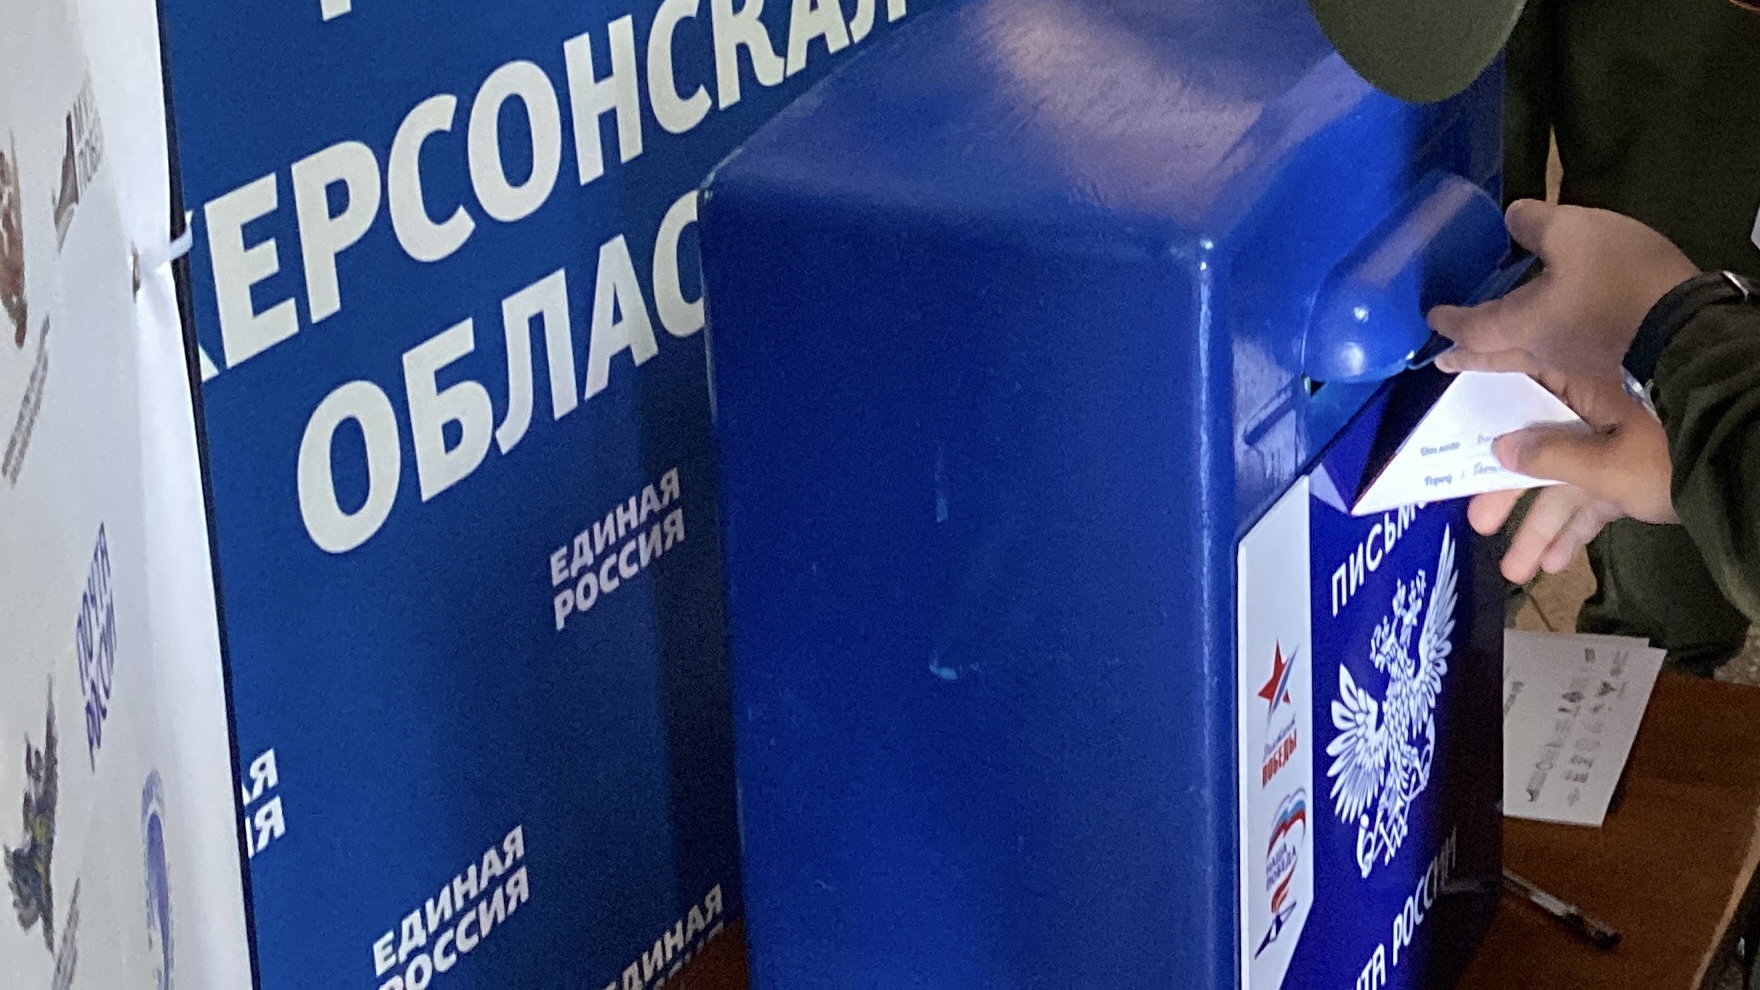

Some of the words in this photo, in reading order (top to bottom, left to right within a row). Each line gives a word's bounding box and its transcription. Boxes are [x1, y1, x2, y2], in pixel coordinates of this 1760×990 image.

[550, 466, 680, 587] ЕДИНАЯ
[554, 505, 685, 631] РОССИЯ
[1331, 502, 1427, 618] ПИСЬМ
[76, 521, 111, 697] ПОЧТА
[373, 824, 525, 977] ЕДИНАЯ
[604, 883, 723, 990] ДИНАЯ
